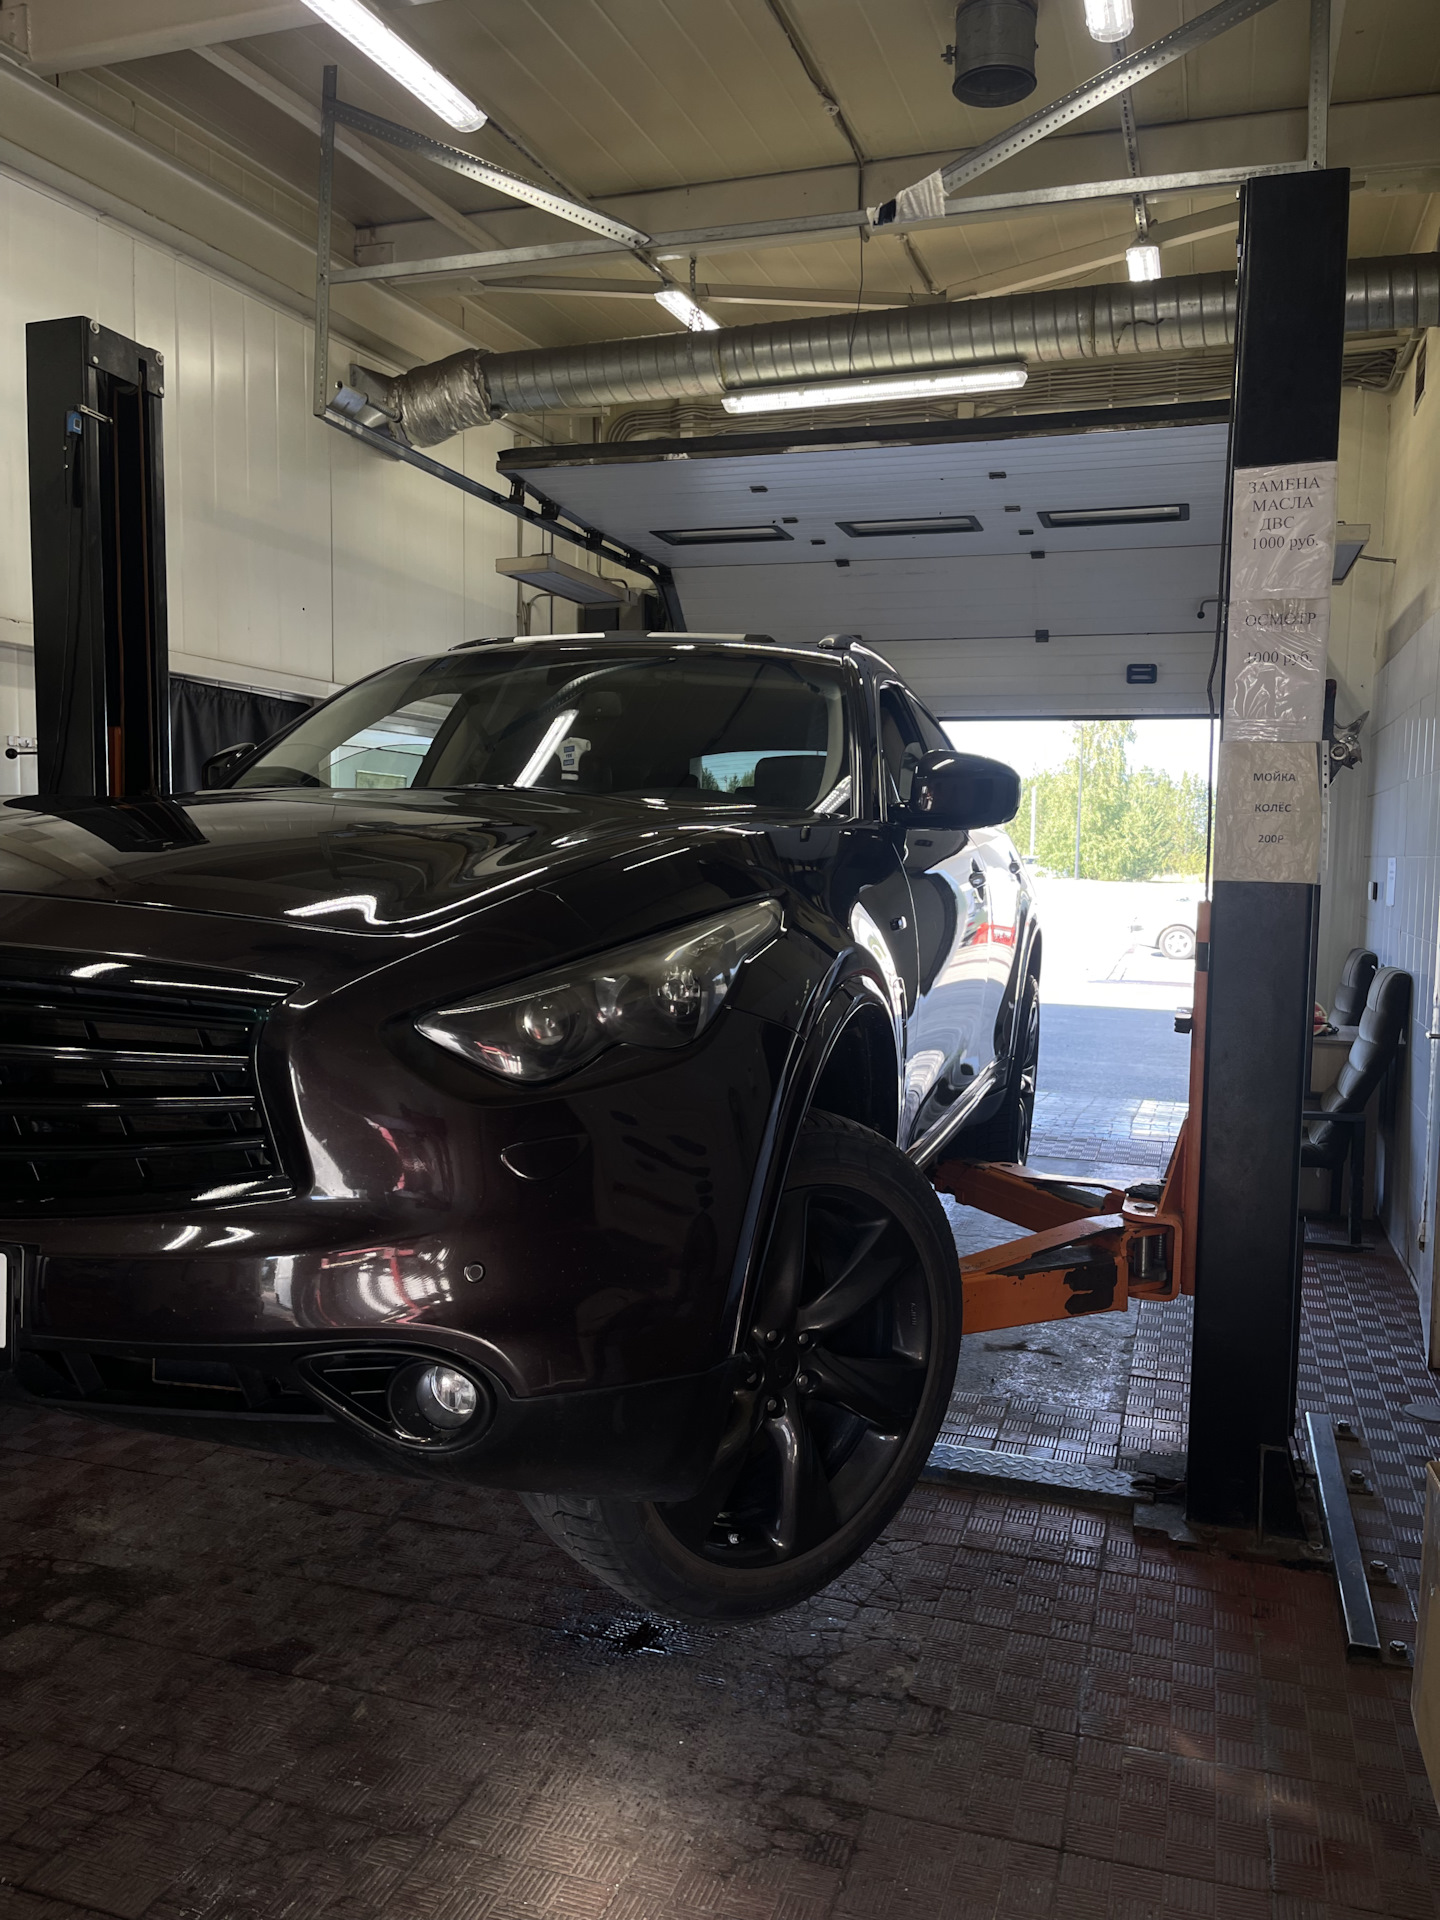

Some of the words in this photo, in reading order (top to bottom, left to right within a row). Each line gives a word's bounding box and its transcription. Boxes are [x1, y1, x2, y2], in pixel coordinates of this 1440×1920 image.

[1248, 477, 1320, 494] ЗАМЕНА
[1252, 496, 1314, 512] МАСЛА
[1260, 516, 1295, 532] ДВС
[1253, 536, 1285, 550] 1000
[1289, 534, 1319, 550] руб.
[1245, 612, 1317, 627] ОСМОТР
[1253, 771, 1296, 782] МОЙКА
